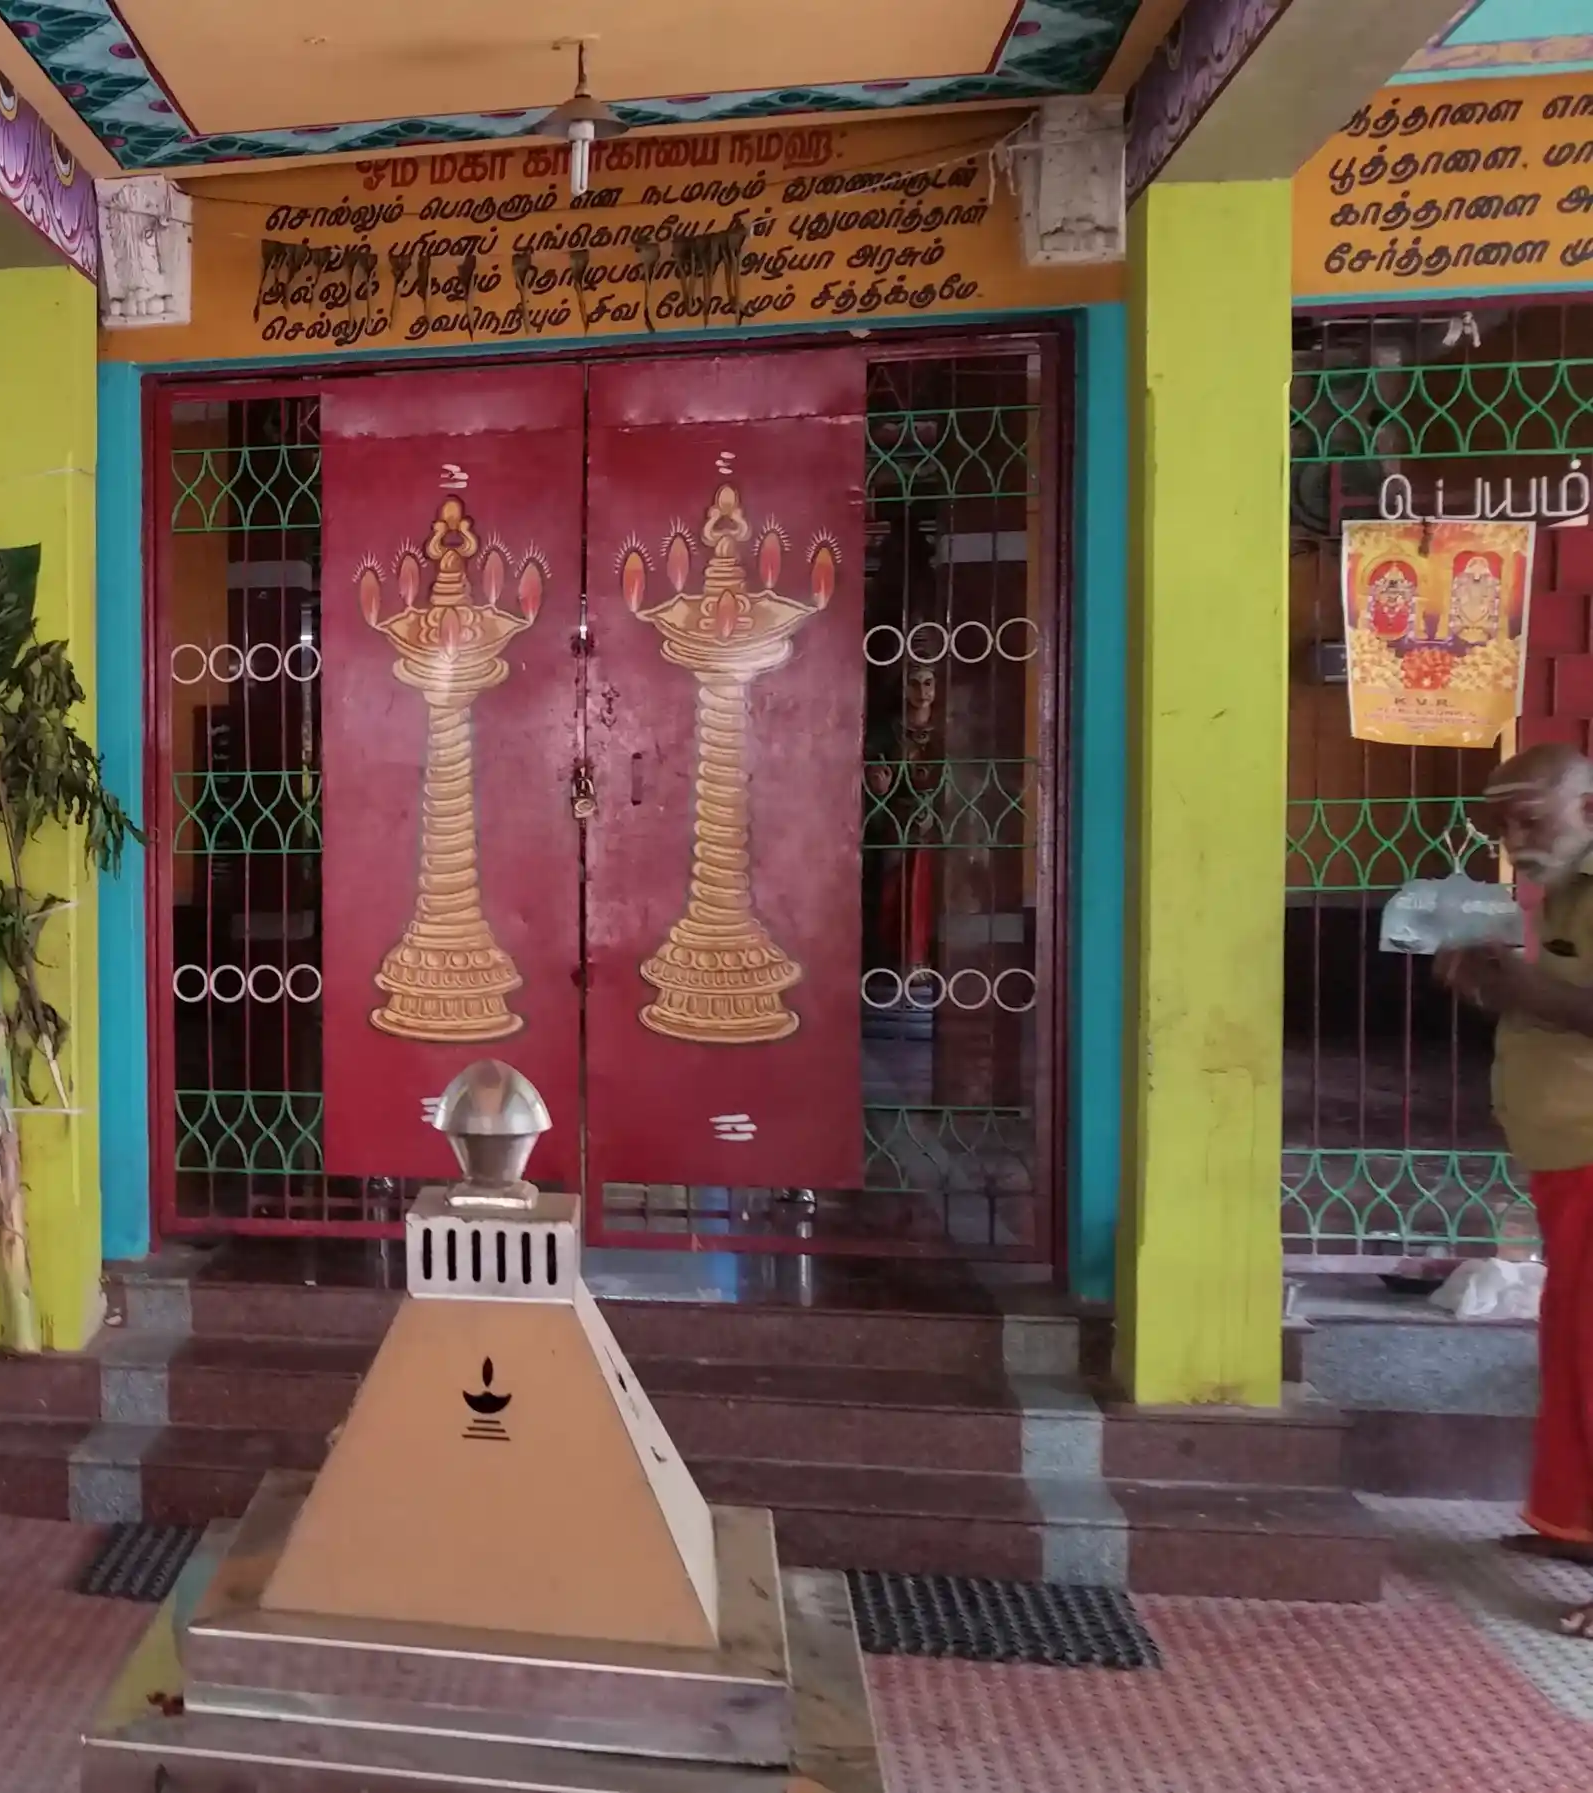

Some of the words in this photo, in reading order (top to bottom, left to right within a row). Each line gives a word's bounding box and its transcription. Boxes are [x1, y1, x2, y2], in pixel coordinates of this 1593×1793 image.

[266, 195, 404, 233] சொல்லும்
[419, 184, 558, 222] பொருளும்
[640, 170, 766, 206] நடமாடும்
[847, 237, 946, 274] அரசும்
